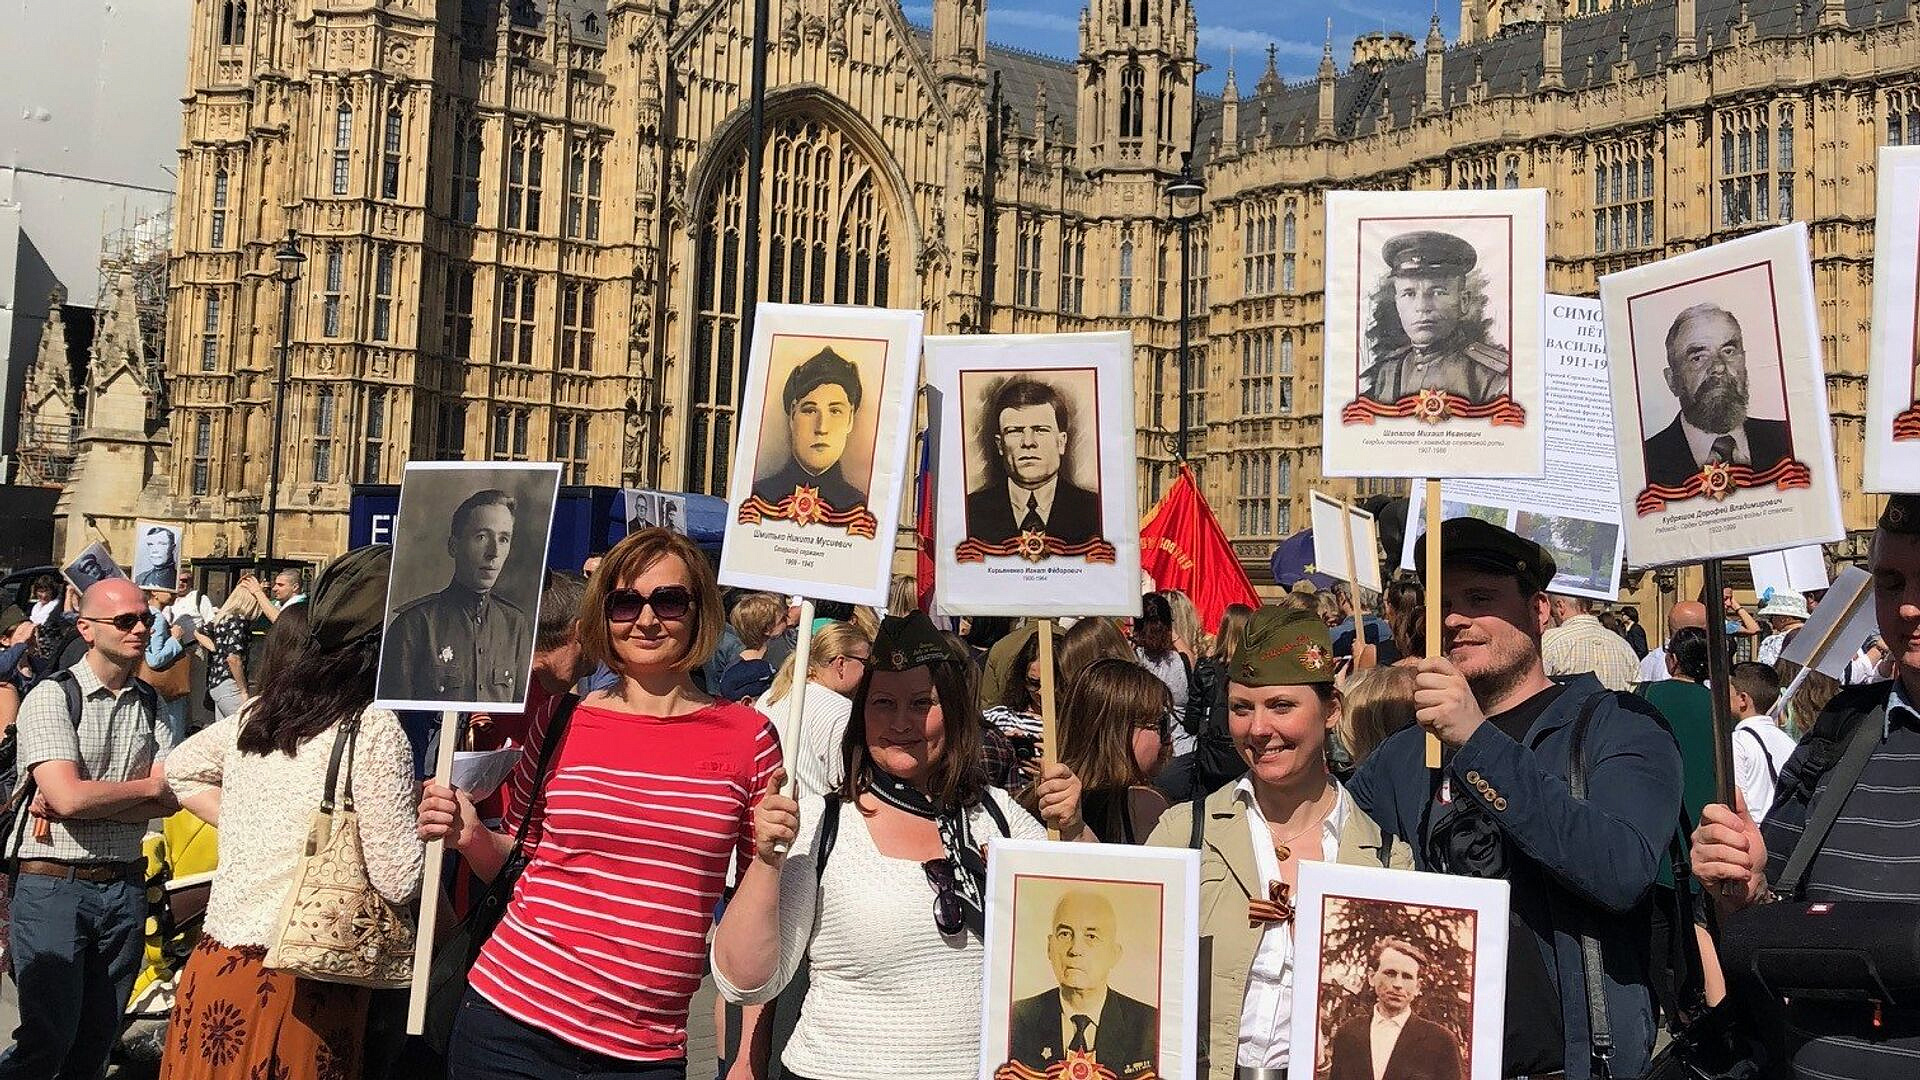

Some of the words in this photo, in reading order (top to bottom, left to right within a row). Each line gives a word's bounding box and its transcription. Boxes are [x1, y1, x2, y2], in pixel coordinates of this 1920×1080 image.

[1445, 430, 1482, 438] Иванович
[1729, 498, 1783, 512] Владимирович
[786, 533, 815, 545] Никита
